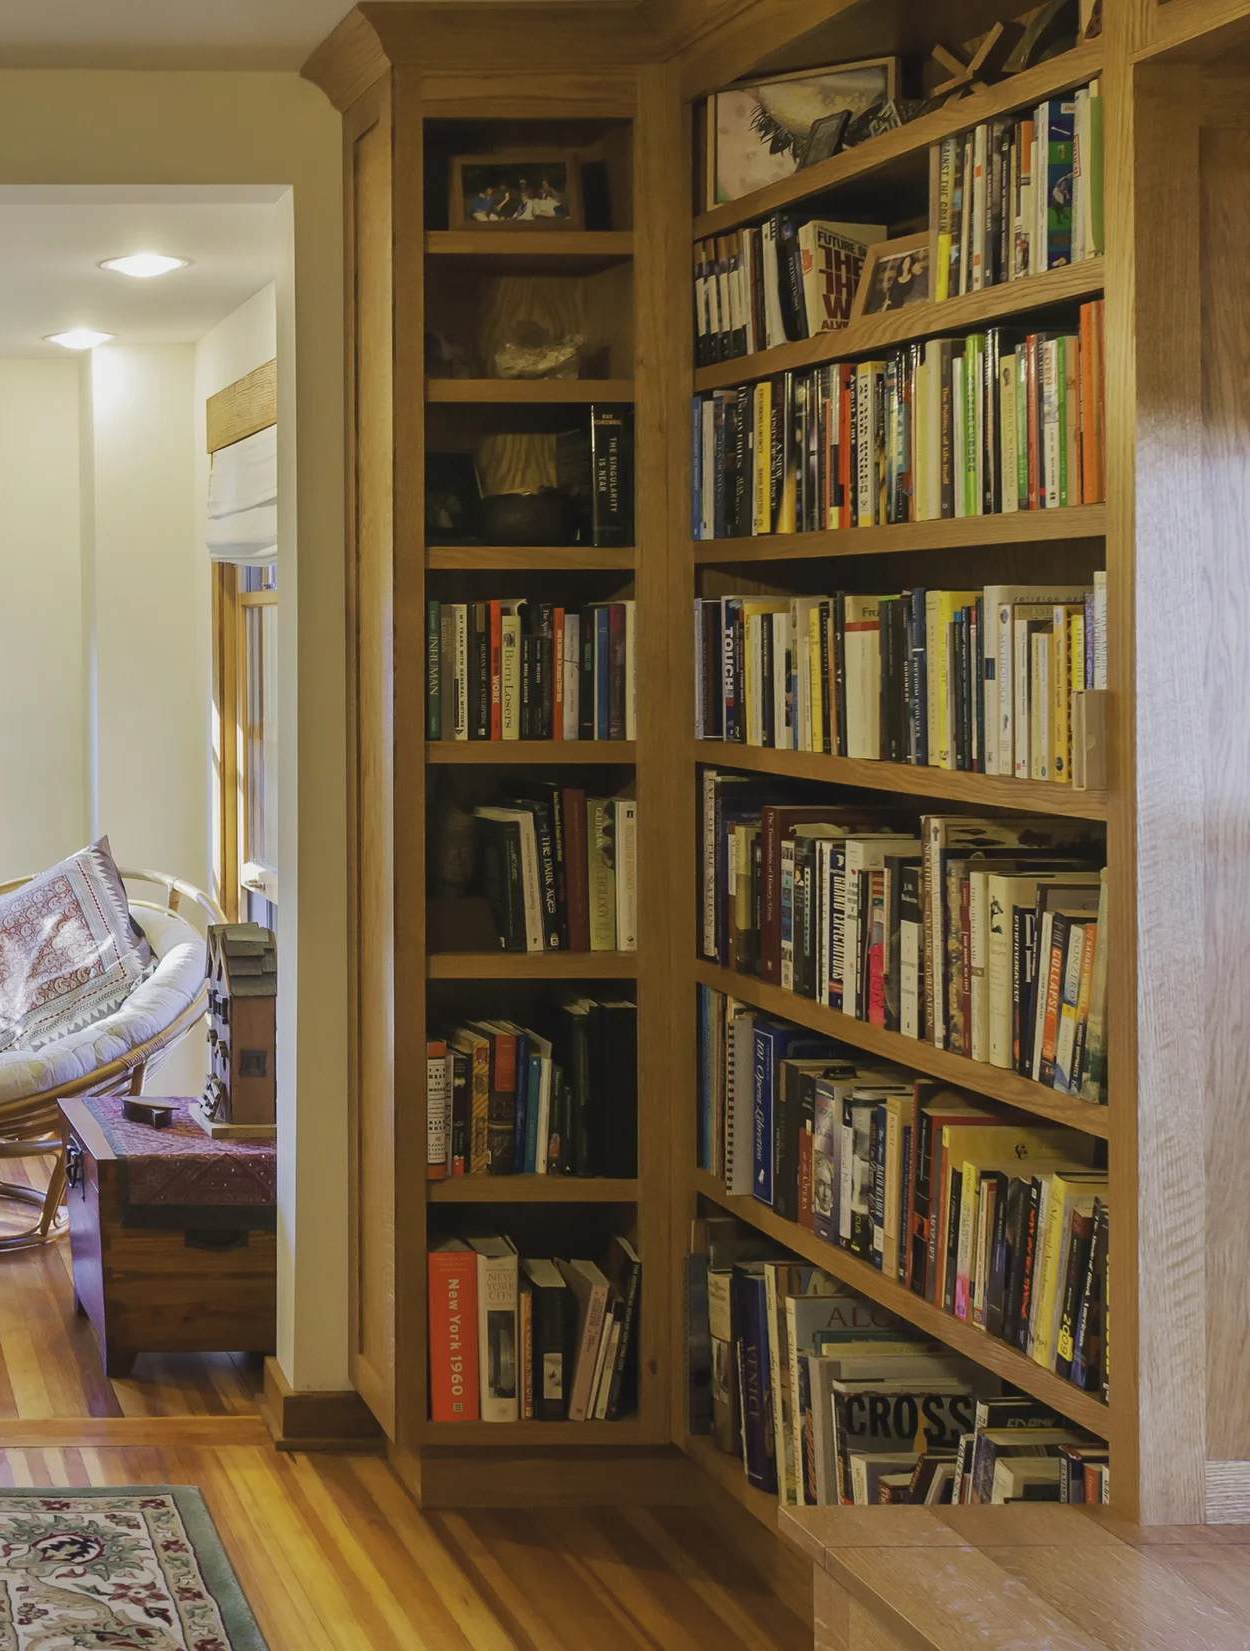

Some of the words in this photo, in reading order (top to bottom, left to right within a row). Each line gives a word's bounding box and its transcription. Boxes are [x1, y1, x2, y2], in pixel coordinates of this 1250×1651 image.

[940, 142, 950, 176] GAINST
[938, 202, 949, 232] GRAIN
[817, 231, 856, 255] FUTURE
[1044, 347, 1053, 386] EDEN
[942, 387, 950, 402] The
[942, 404, 950, 434] Politics
[598, 458, 607, 466] IS
[609, 437, 618, 454] THE
[942, 447, 950, 462] Life
[942, 464, 950, 485] Itself
[1007, 437, 1015, 488] WINSTON
[598, 468, 607, 492] NEAR
[609, 456, 619, 513] SINGULARITY
[459, 614, 464, 626] MY
[429, 636, 439, 695] INHUMAN
[504, 650, 514, 682] Born
[724, 627, 735, 690] TOUCH
[999, 633, 1008, 704] MYTHOLOGY
[492, 674, 500, 704] WORK
[913, 657, 921, 696] FREEDOM
[504, 684, 514, 729] Losers
[914, 699, 922, 738] EVOLVES
[595, 807, 604, 849] GLEITMAN
[708, 818, 715, 836] OF
[541, 837, 551, 857] THE
[543, 859, 553, 885] DARK
[924, 842, 933, 893] NEOLITHIC
[707, 875, 715, 927] NATION
[833, 876, 846, 910] GRAND
[832, 912, 846, 980] EXPECTATIONS
[925, 911, 933, 958] CYCLADIC
[1068, 934, 1083, 1001] NONZERO
[1082, 940, 1093, 970] SARAH
[926, 962, 934, 1027] CIVILIZATION
[1046, 948, 1062, 1015] COLLAPSE
[1079, 973, 1091, 1008] VOWELL
[756, 1038, 765, 1061] 101
[1072, 1046, 1081, 1078] SHIPMATES
[754, 1065, 765, 1106] Opera
[755, 1106, 765, 1161] Librettos
[888, 1116, 896, 1146] BACH
[842, 1127, 851, 1170] Classical
[841, 1172, 850, 1201] Music
[875, 1164, 885, 1185] BACH
[875, 1187, 885, 1218] READER
[928, 1212, 937, 1262] MOZART
[447, 1277, 461, 1310] New
[486, 1282, 515, 1291] YORK
[488, 1273, 513, 1281] NEW
[627, 1275, 638, 1307] HISTORICAL
[1084, 1271, 1093, 1297] Black
[488, 1291, 514, 1300] CITY
[448, 1314, 462, 1351] York
[621, 1331, 629, 1344] NEW
[1059, 1313, 1072, 1355] 2009
[1077, 1301, 1090, 1347] Americans
[525, 1362, 532, 1370] IN
[617, 1358, 625, 1372] CITY
[619, 1344, 627, 1358] YORK
[788, 1330, 796, 1393] PEINTRES
[450, 1355, 464, 1396] 1960
[746, 1344, 760, 1422] VENICE
[846, 1396, 973, 1440] CROSS
